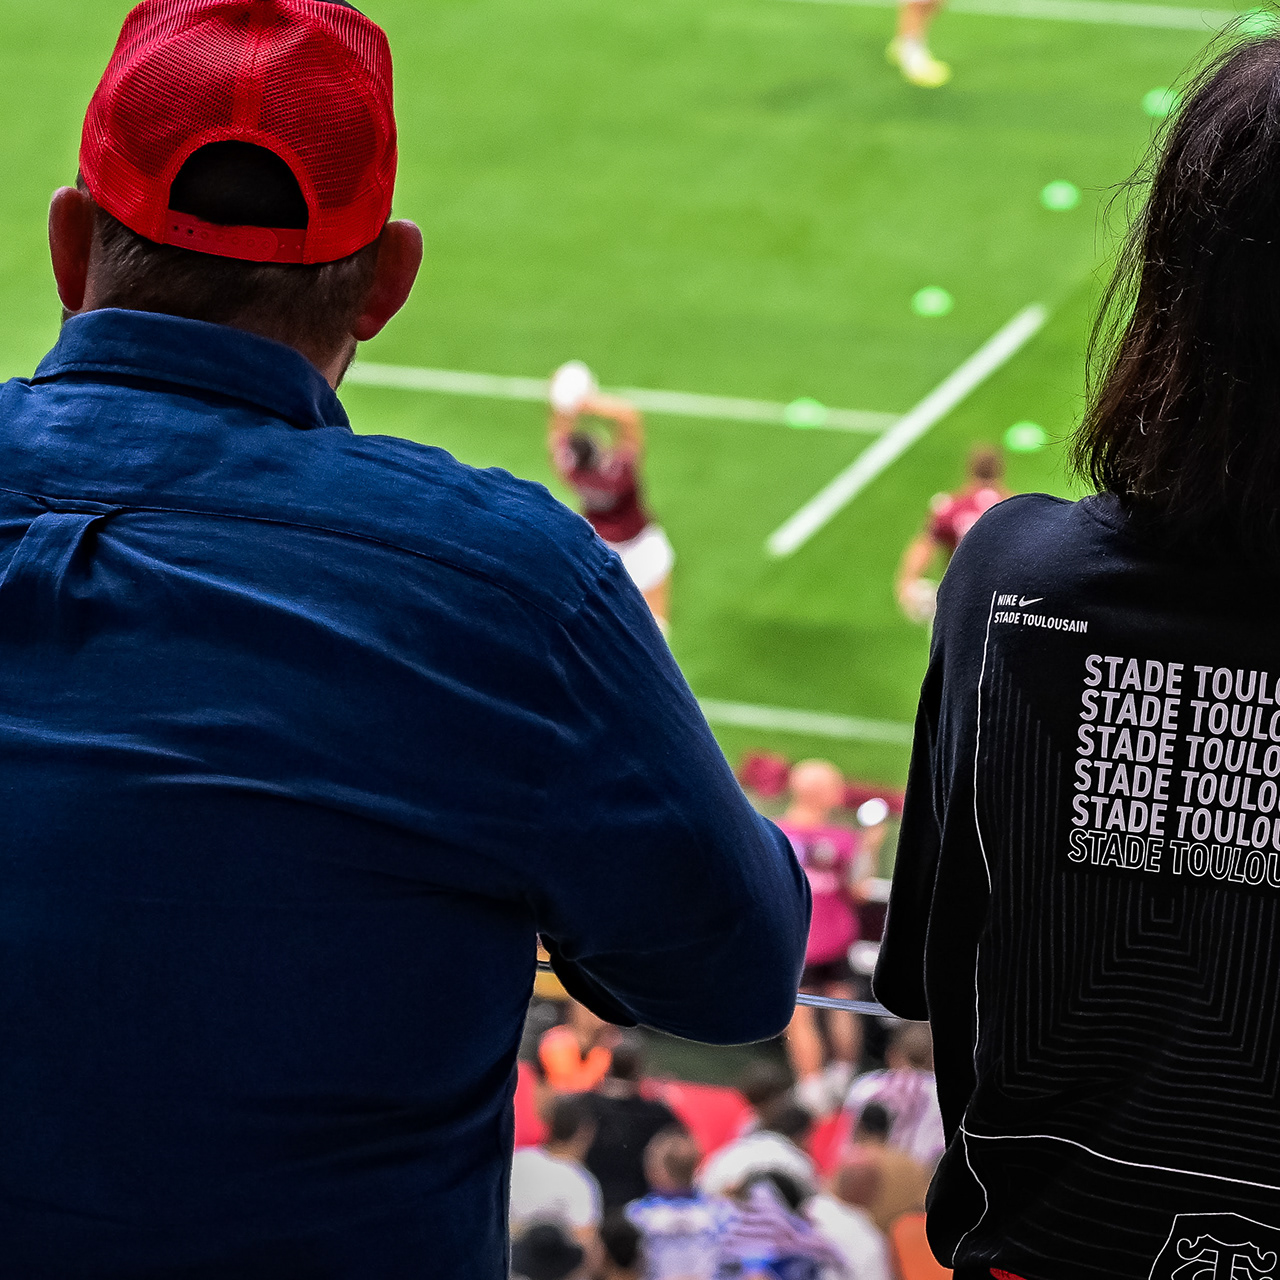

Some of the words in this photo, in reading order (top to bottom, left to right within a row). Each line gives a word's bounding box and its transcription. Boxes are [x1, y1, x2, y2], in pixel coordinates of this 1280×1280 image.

[997, 594, 1019, 606] NIKE
[993, 611, 1021, 624] STADE
[1022, 613, 1088, 633] TOULOUSAIN
[1083, 654, 1184, 695] STADE
[1079, 689, 1180, 730] STADE
[1076, 723, 1177, 766] STADE
[1073, 758, 1172, 801] STADE
[1070, 793, 1168, 836] STADE
[1067, 828, 1163, 872] STADE
